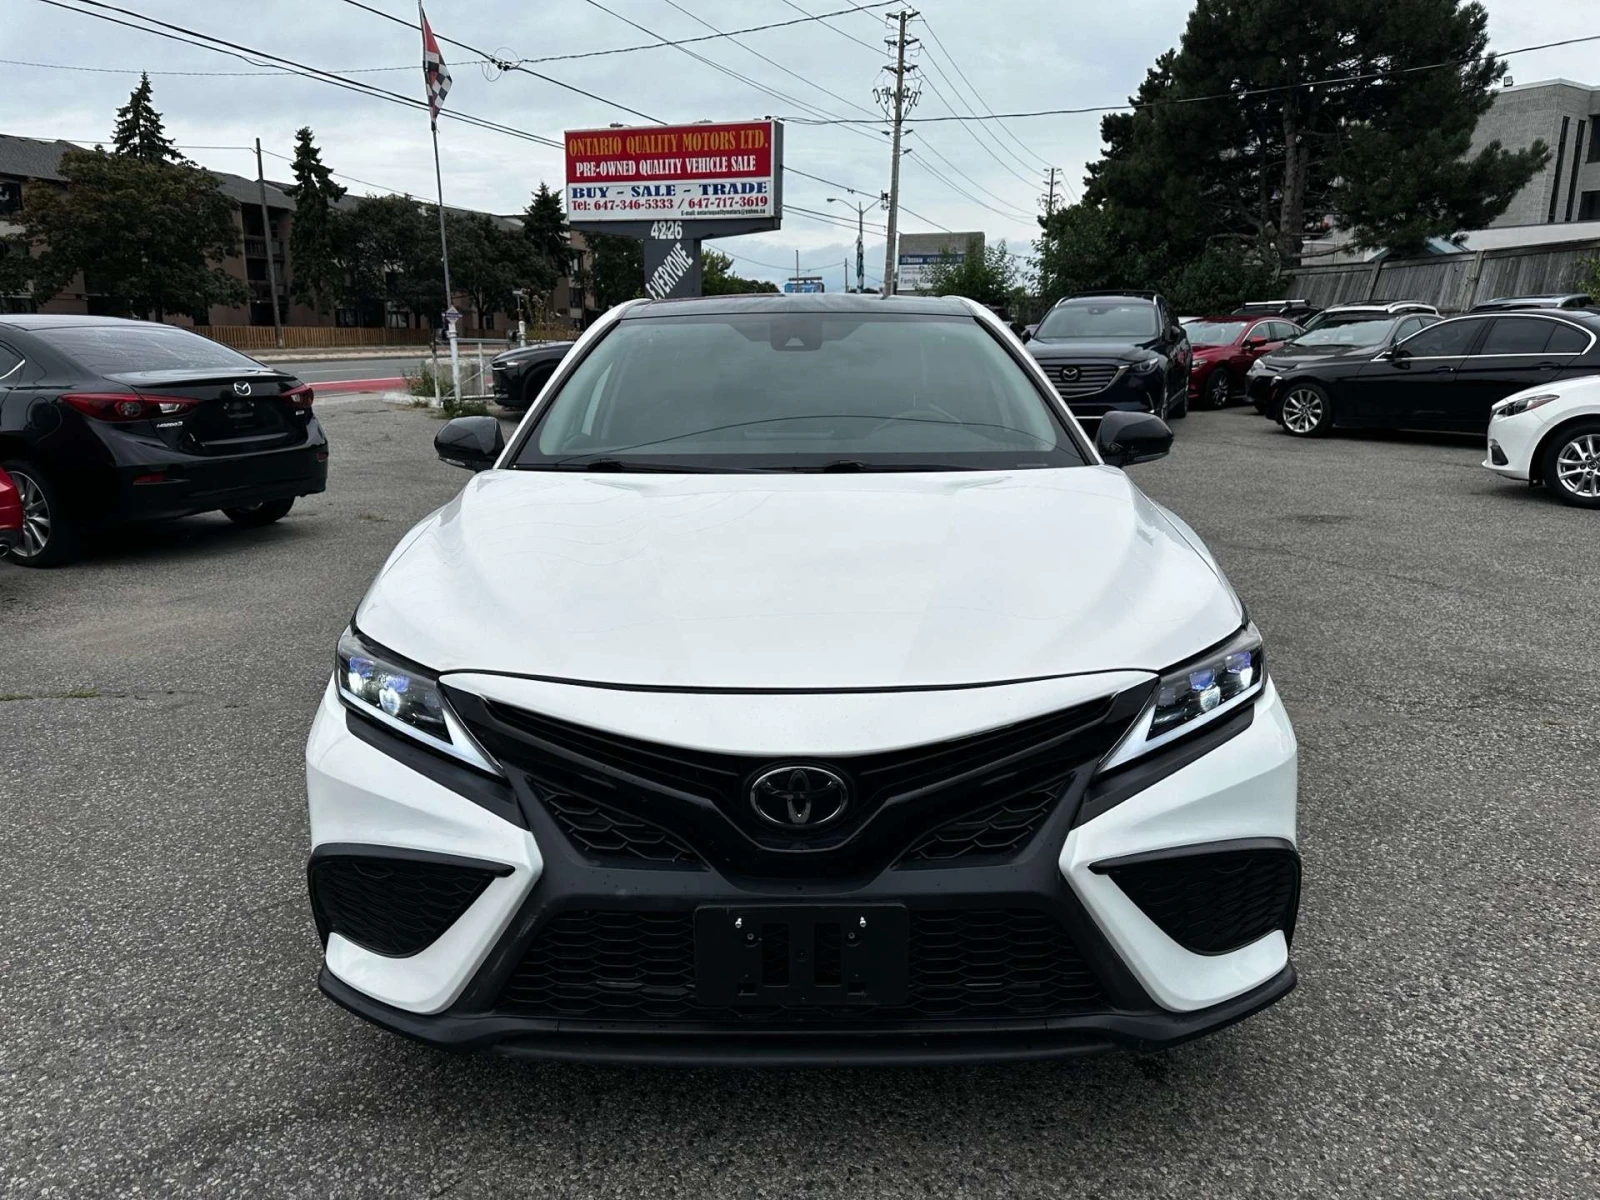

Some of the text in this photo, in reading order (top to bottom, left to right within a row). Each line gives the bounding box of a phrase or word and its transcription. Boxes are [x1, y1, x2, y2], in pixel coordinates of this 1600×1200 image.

[569, 129, 768, 157] ONTARIO QUALITY MOTORS LTD.
[576, 156, 756, 177] PRE-OWNED QUALITY VEHICLE SALE
[572, 187, 610, 198] BUY
[631, 185, 676, 197] SALE
[699, 182, 767, 195] TRADE
[572, 201, 590, 211] Tel:
[594, 199, 673, 210] 647-346-5333
[688, 196, 768, 208] 647-717-3619
[651, 221, 682, 239] 4226
[645, 242, 693, 300] EVERYONE
